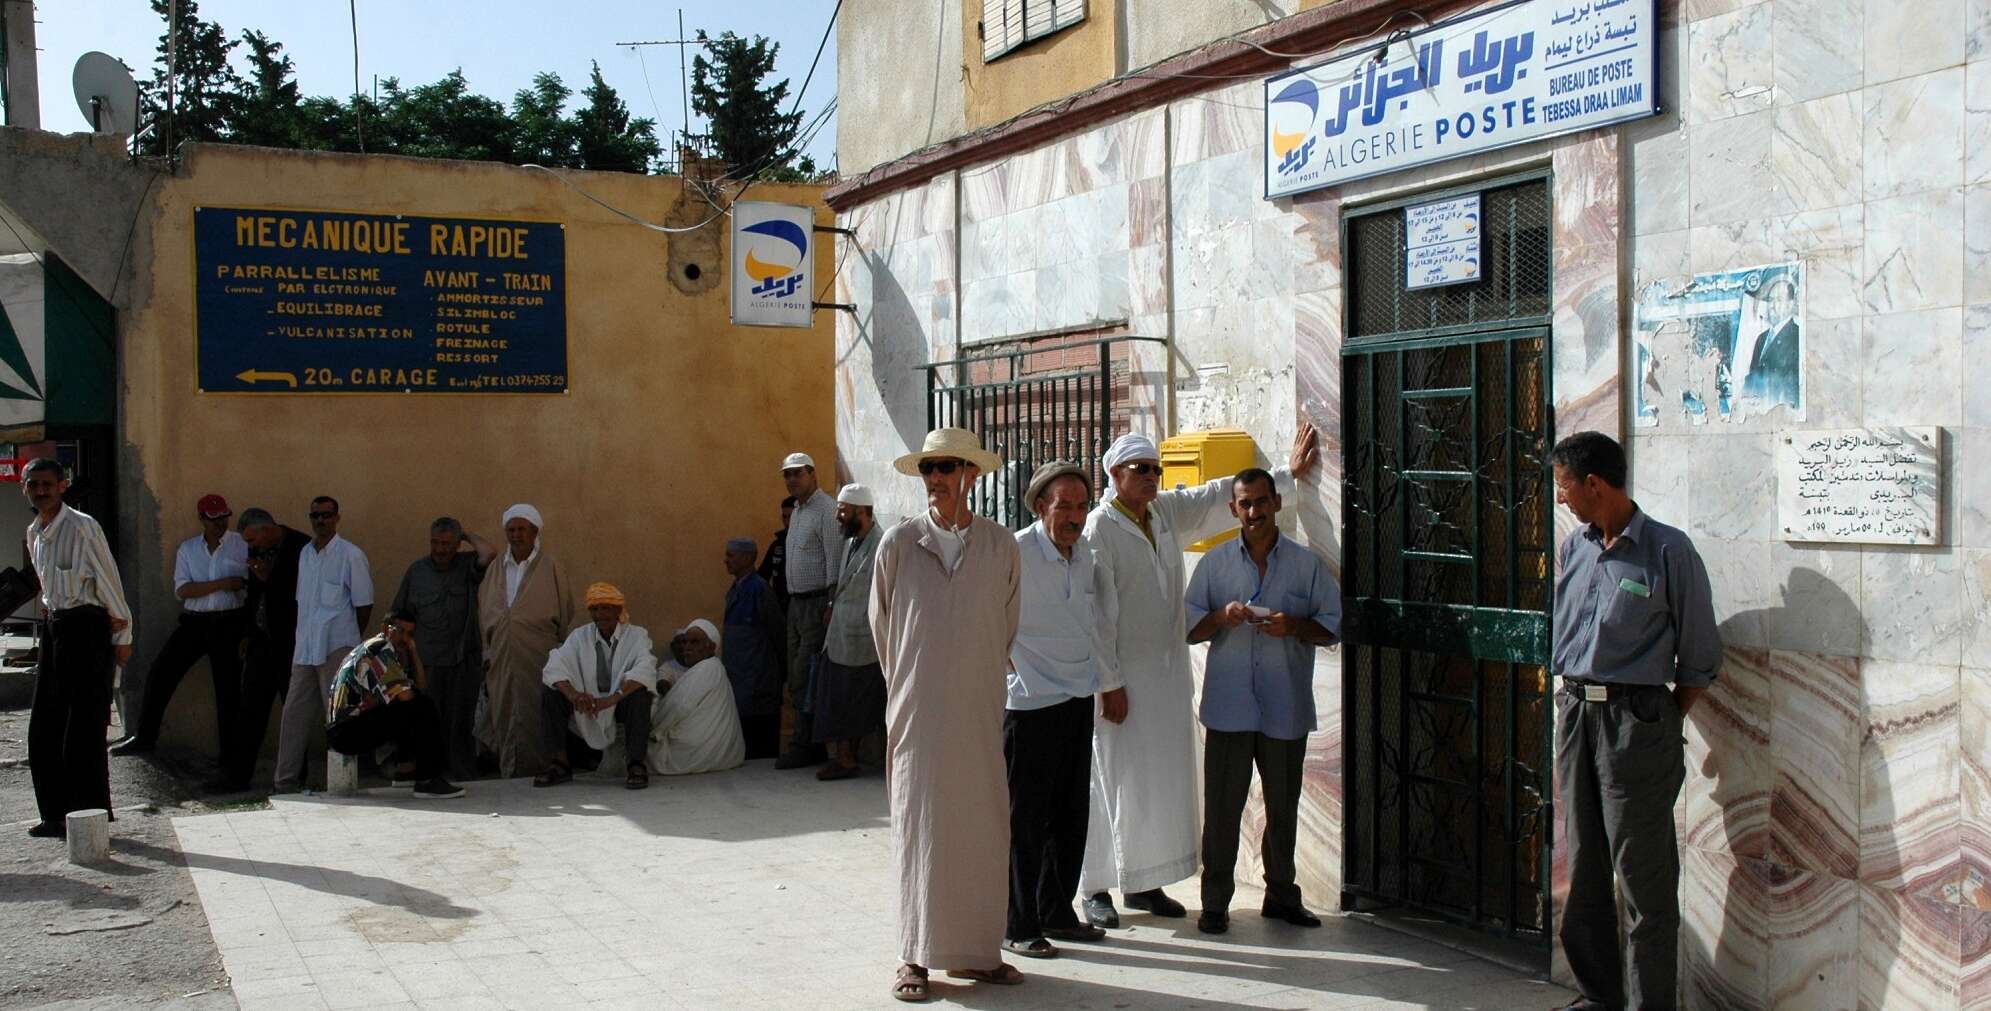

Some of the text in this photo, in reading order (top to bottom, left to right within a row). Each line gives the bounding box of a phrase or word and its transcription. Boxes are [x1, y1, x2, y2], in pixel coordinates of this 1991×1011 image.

[1552, 3, 1590, 25] بريد
[1604, 14, 1637, 41] تبسة
[1325, 31, 1535, 137] بريد الجزائر
[1550, 58, 1633, 97] BUREAU DE POSTE
[1542, 83, 1642, 123] TEBESSA DRAA LIMAM
[1323, 96, 1535, 171] ALGERIE POSTE
[1299, 171, 1319, 184] POSTE
[236, 216, 529, 259] MECANIQUE RAPIDE
[217, 265, 381, 281] PARRALLELISME
[424, 270, 479, 288] AVANT
[503, 273, 552, 291] TRAIN
[278, 283, 305, 294] PAR
[313, 284, 397, 296] ELCTRONIQUE
[750, 301, 805, 310] ALGERIE POSTE
[436, 323, 491, 334] ROTULE
[436, 352, 499, 363] RESSORT
